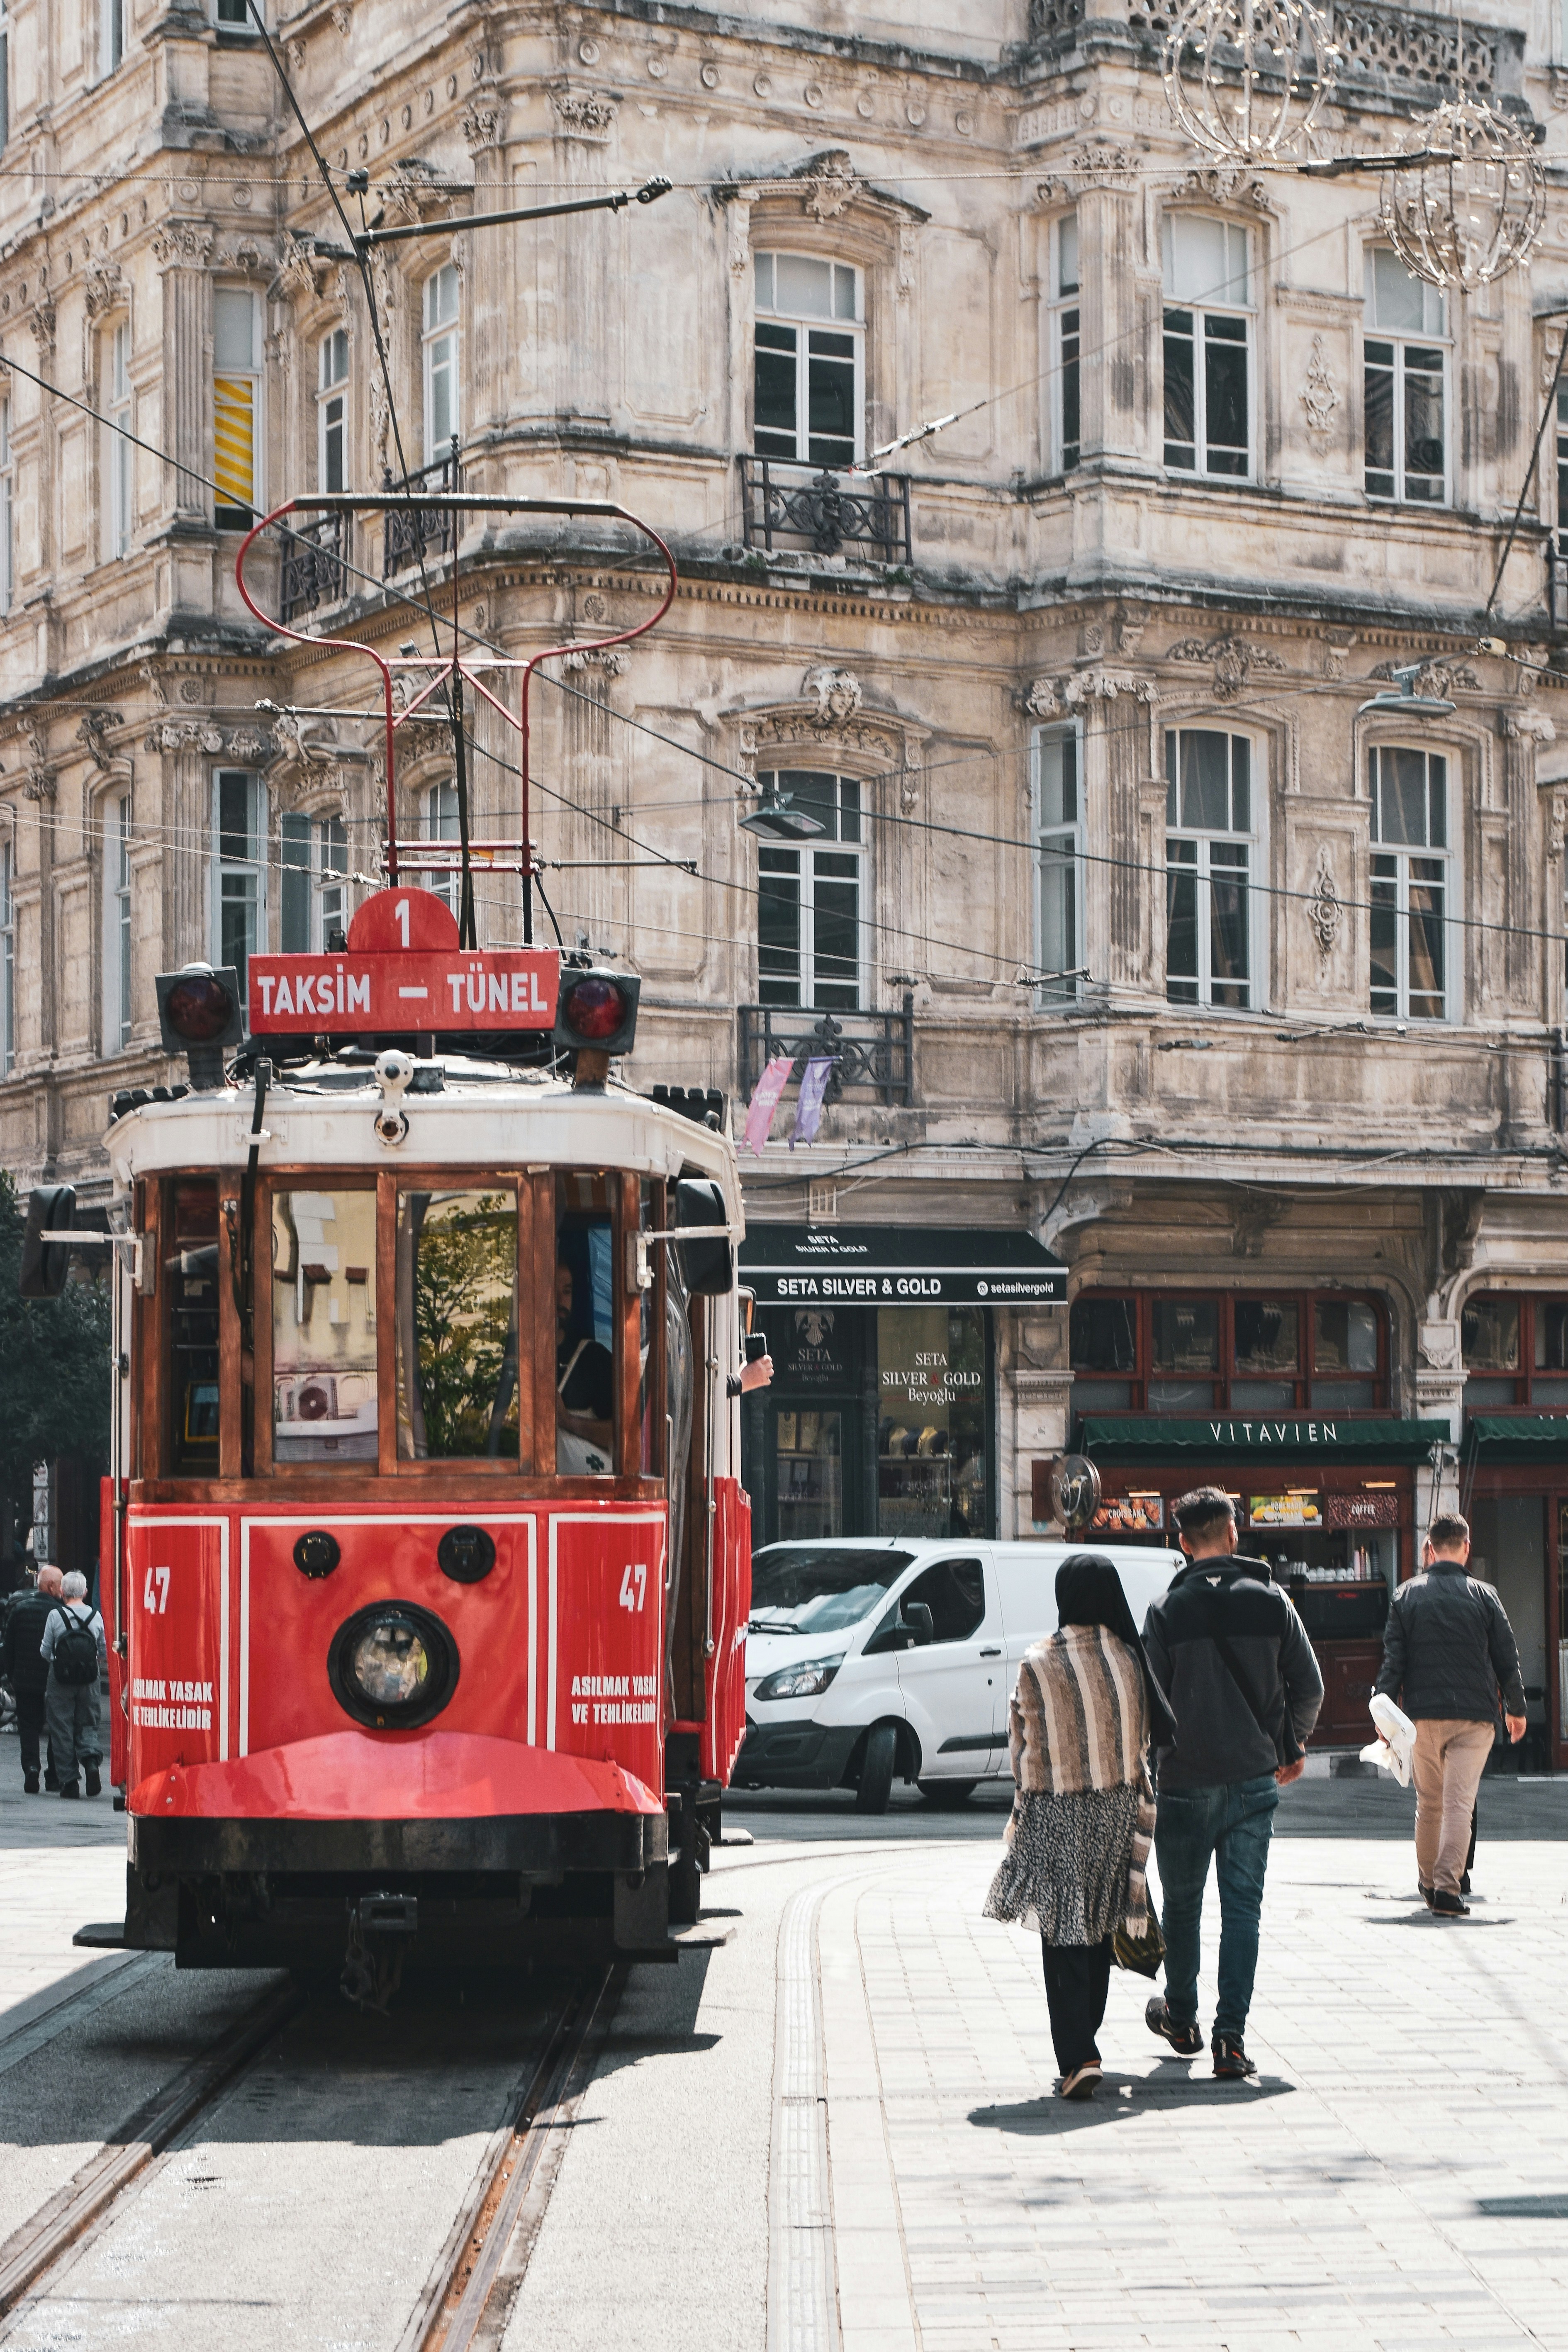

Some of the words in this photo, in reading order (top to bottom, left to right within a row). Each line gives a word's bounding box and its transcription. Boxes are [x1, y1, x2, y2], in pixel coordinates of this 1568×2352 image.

[395, 899, 409, 948] 1
[257, 964, 370, 1015] TAKSİM
[447, 963, 547, 1013] TÜNEL
[807, 1235, 839, 1244] SETA
[777, 1278, 818, 1295] SETA
[822, 1278, 876, 1295] SILVER
[882, 1278, 892, 1295] &
[897, 1278, 941, 1295] GOLD
[991, 1282, 1054, 1295] setasilvergold
[798, 1349, 831, 1361] SETA
[915, 1352, 947, 1366] SETA
[882, 1371, 928, 1385] SILVER
[943, 1371, 981, 1385] GOLD
[908, 1387, 956, 1406] Beyoğlu
[1210, 1422, 1337, 1442] VITAVIEN
[1351, 1504, 1374, 1515] COFFEE
[144, 1566, 170, 1615] 47
[619, 1563, 647, 1612] 47
[133, 1678, 166, 1701] ASILMAK
[169, 1680, 213, 1703] YASAK
[571, 1675, 630, 1697] ASILMAK
[140, 1704, 212, 1730] TEHLİKELİDİR
[572, 1703, 588, 1724] VE
[593, 1699, 656, 1724] TEHLİKELİDİR
